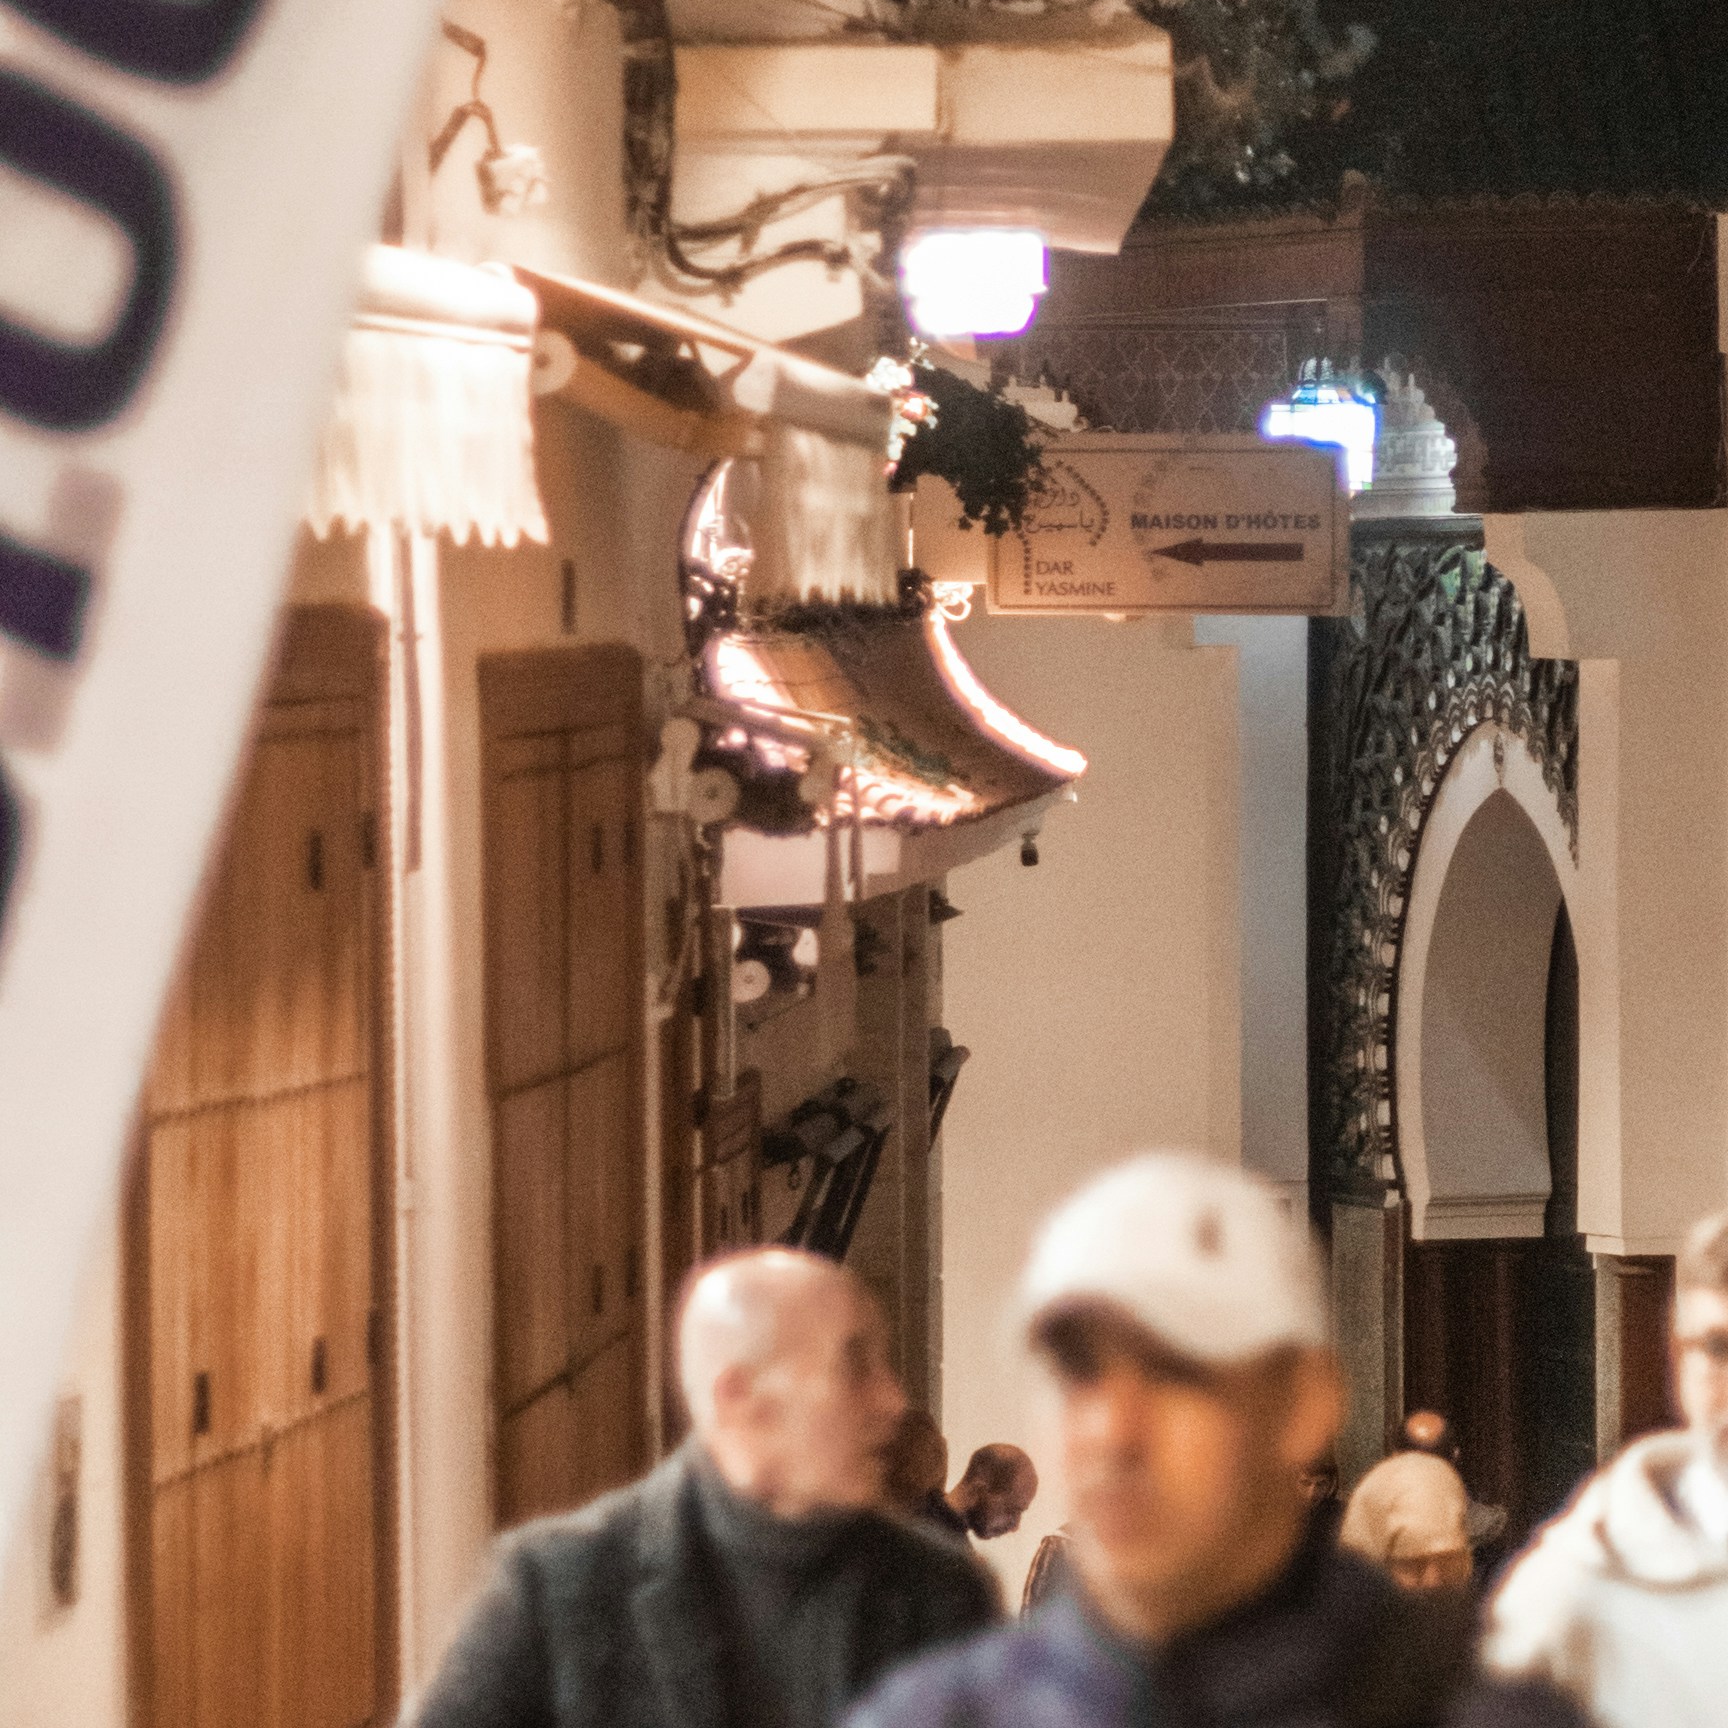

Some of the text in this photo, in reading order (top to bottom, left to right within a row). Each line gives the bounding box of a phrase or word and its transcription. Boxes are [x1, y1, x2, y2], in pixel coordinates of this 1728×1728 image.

[1130, 509, 1321, 530] MAISON D'HÔTES
[1036, 561, 1074, 575] DAR
[1036, 581, 1116, 596] YASMINE
